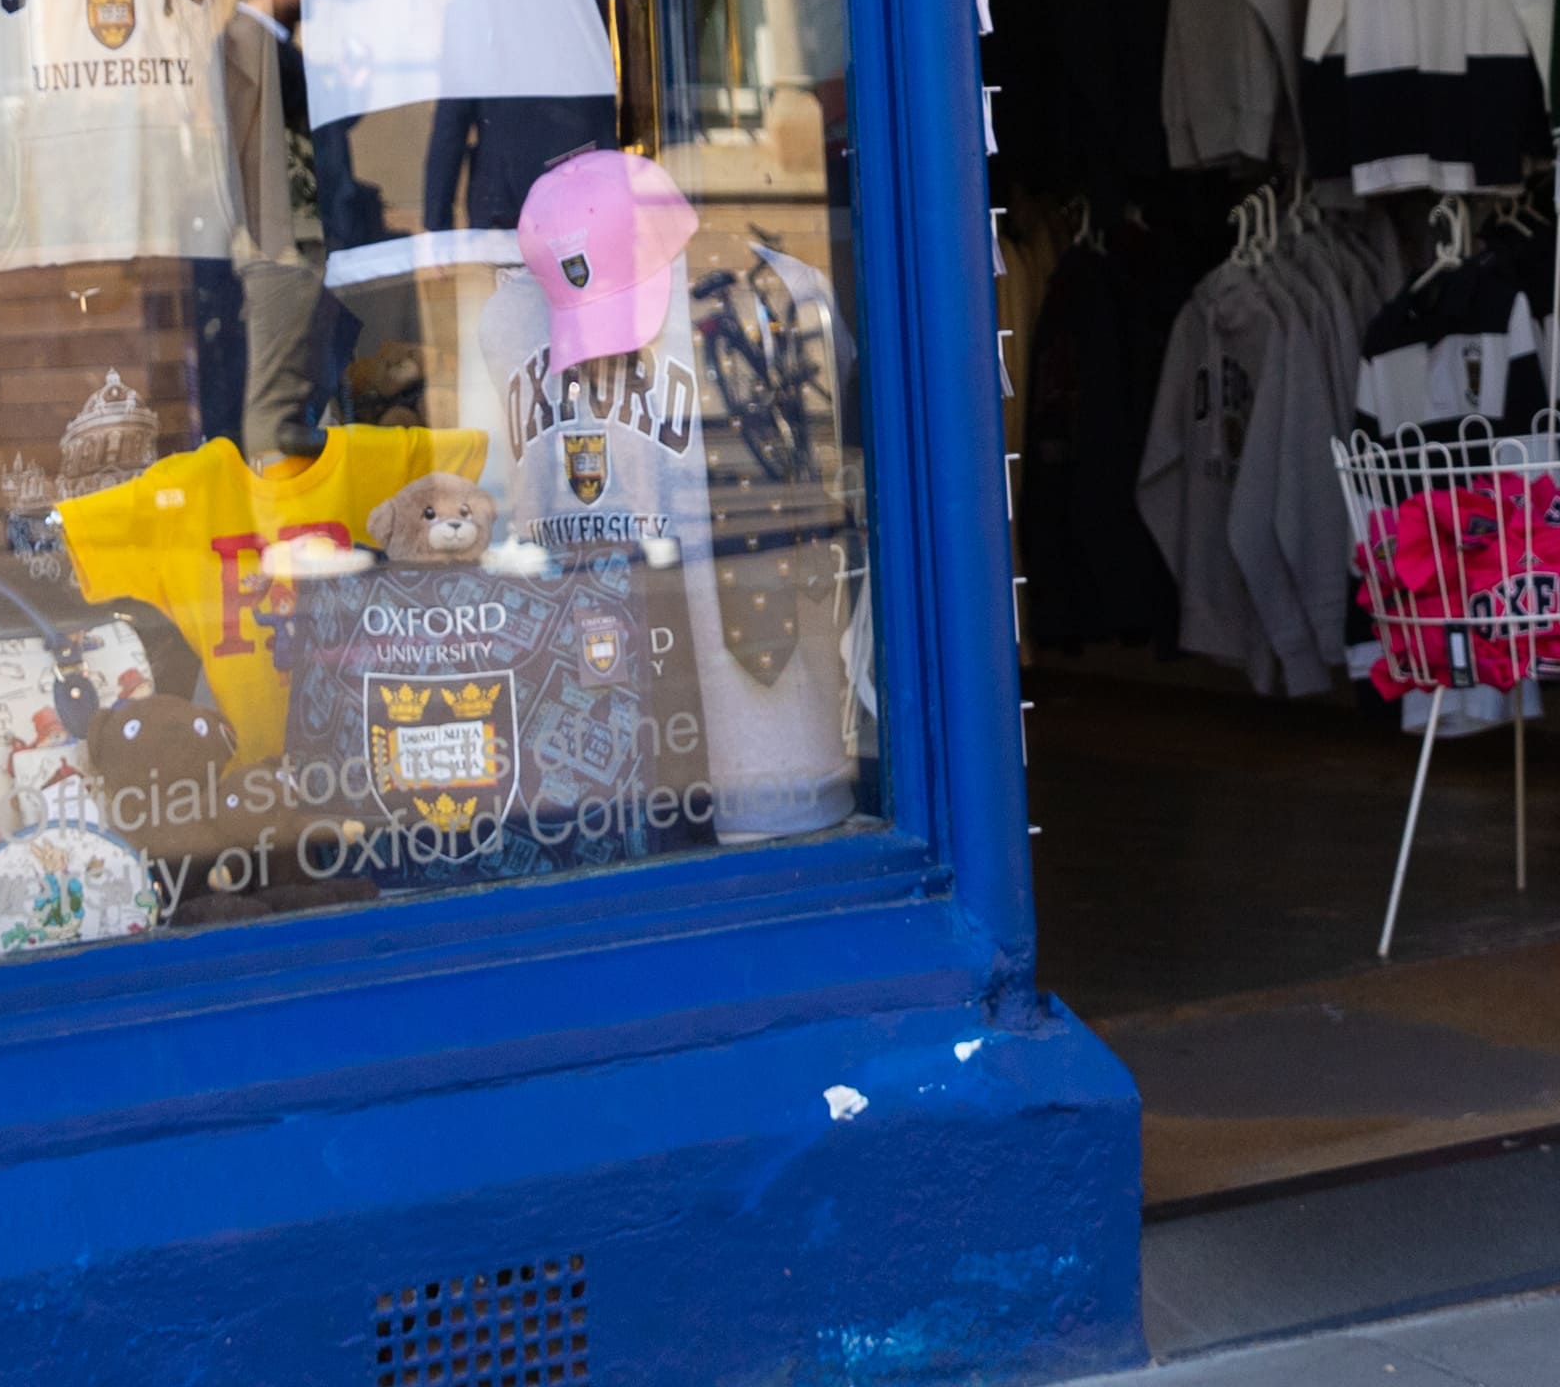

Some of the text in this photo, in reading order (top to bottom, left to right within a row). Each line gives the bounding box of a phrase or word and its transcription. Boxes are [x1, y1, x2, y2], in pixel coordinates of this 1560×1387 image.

[363, 601, 507, 638] OXFORD
[376, 641, 493, 665] UNIVERSITY
[220, 827, 279, 893] of
[297, 795, 503, 881] Oxford
